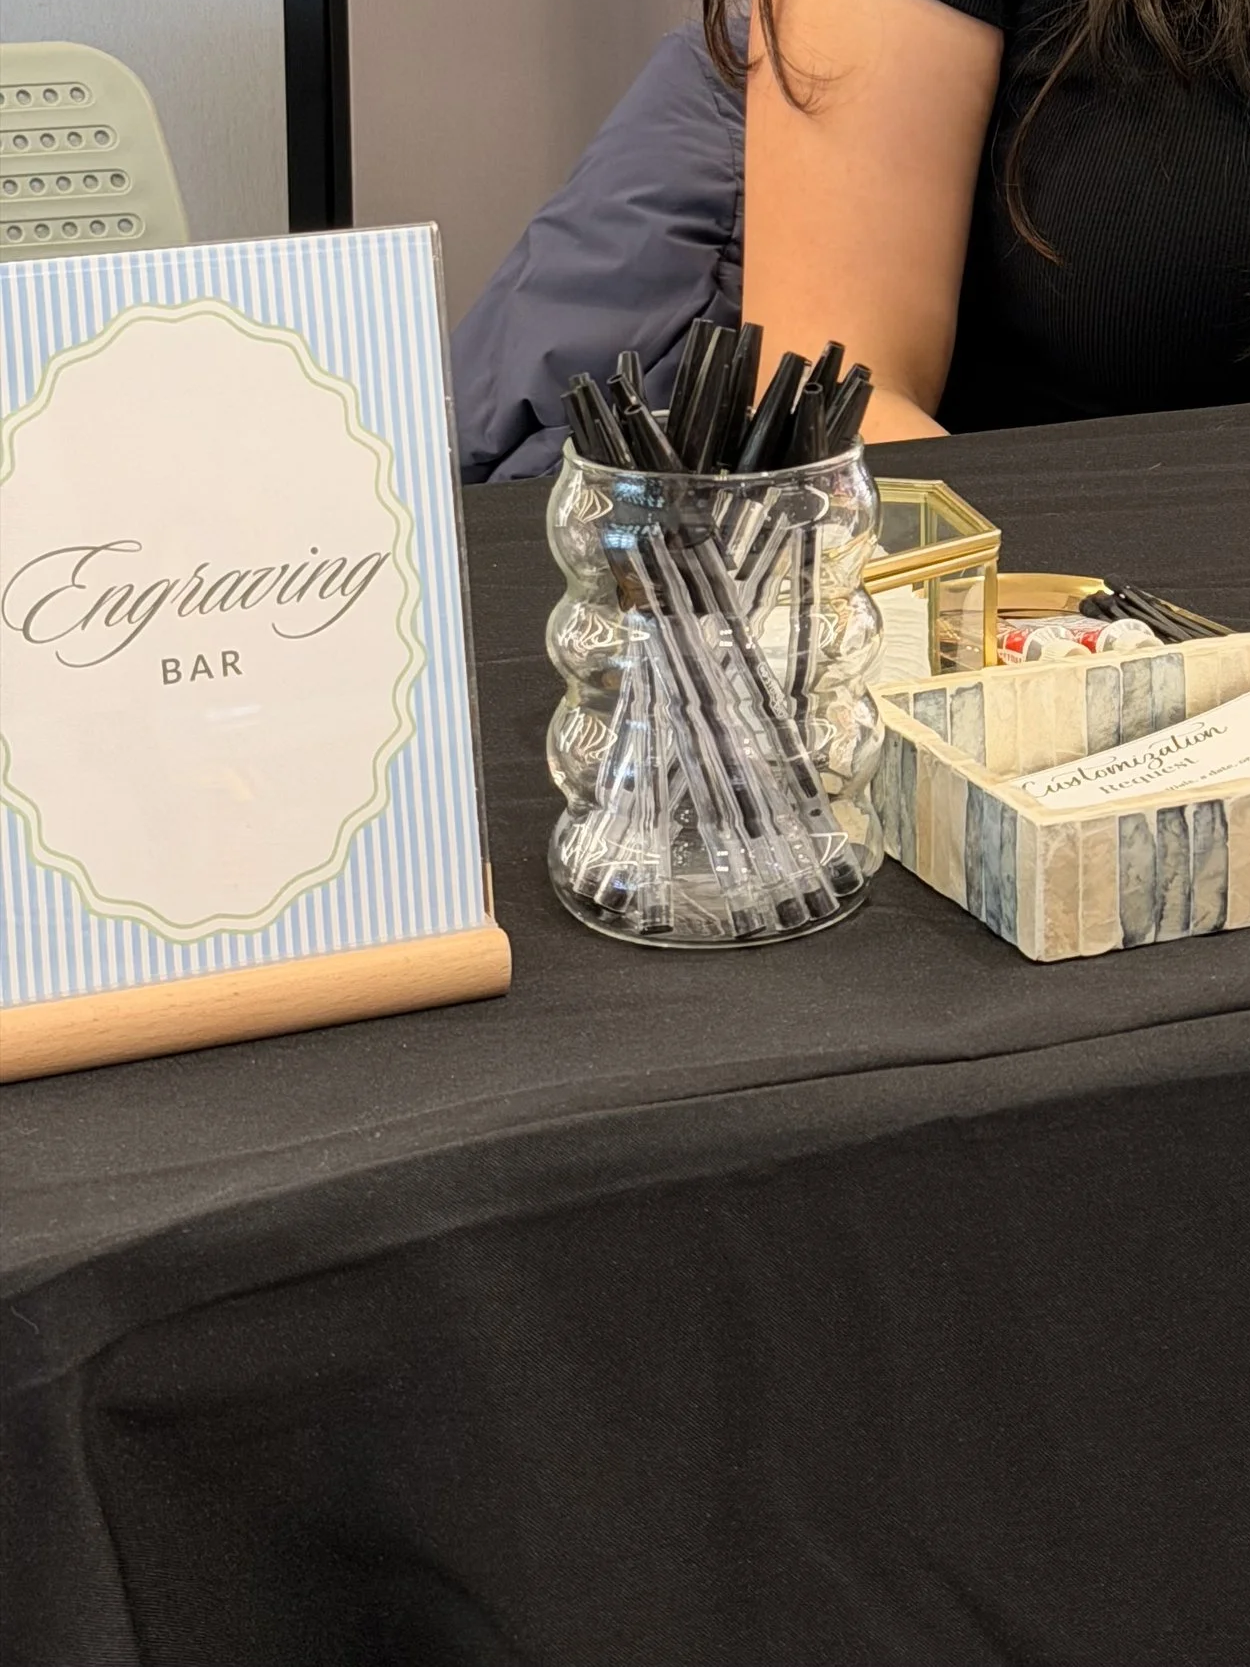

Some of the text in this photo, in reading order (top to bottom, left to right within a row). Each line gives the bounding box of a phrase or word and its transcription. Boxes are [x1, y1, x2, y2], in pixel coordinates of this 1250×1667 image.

[1, 540, 391, 668] Engraving
[161, 650, 244, 685] BAR
[1021, 721, 1229, 799] Customization
[1099, 757, 1200, 795] Request
